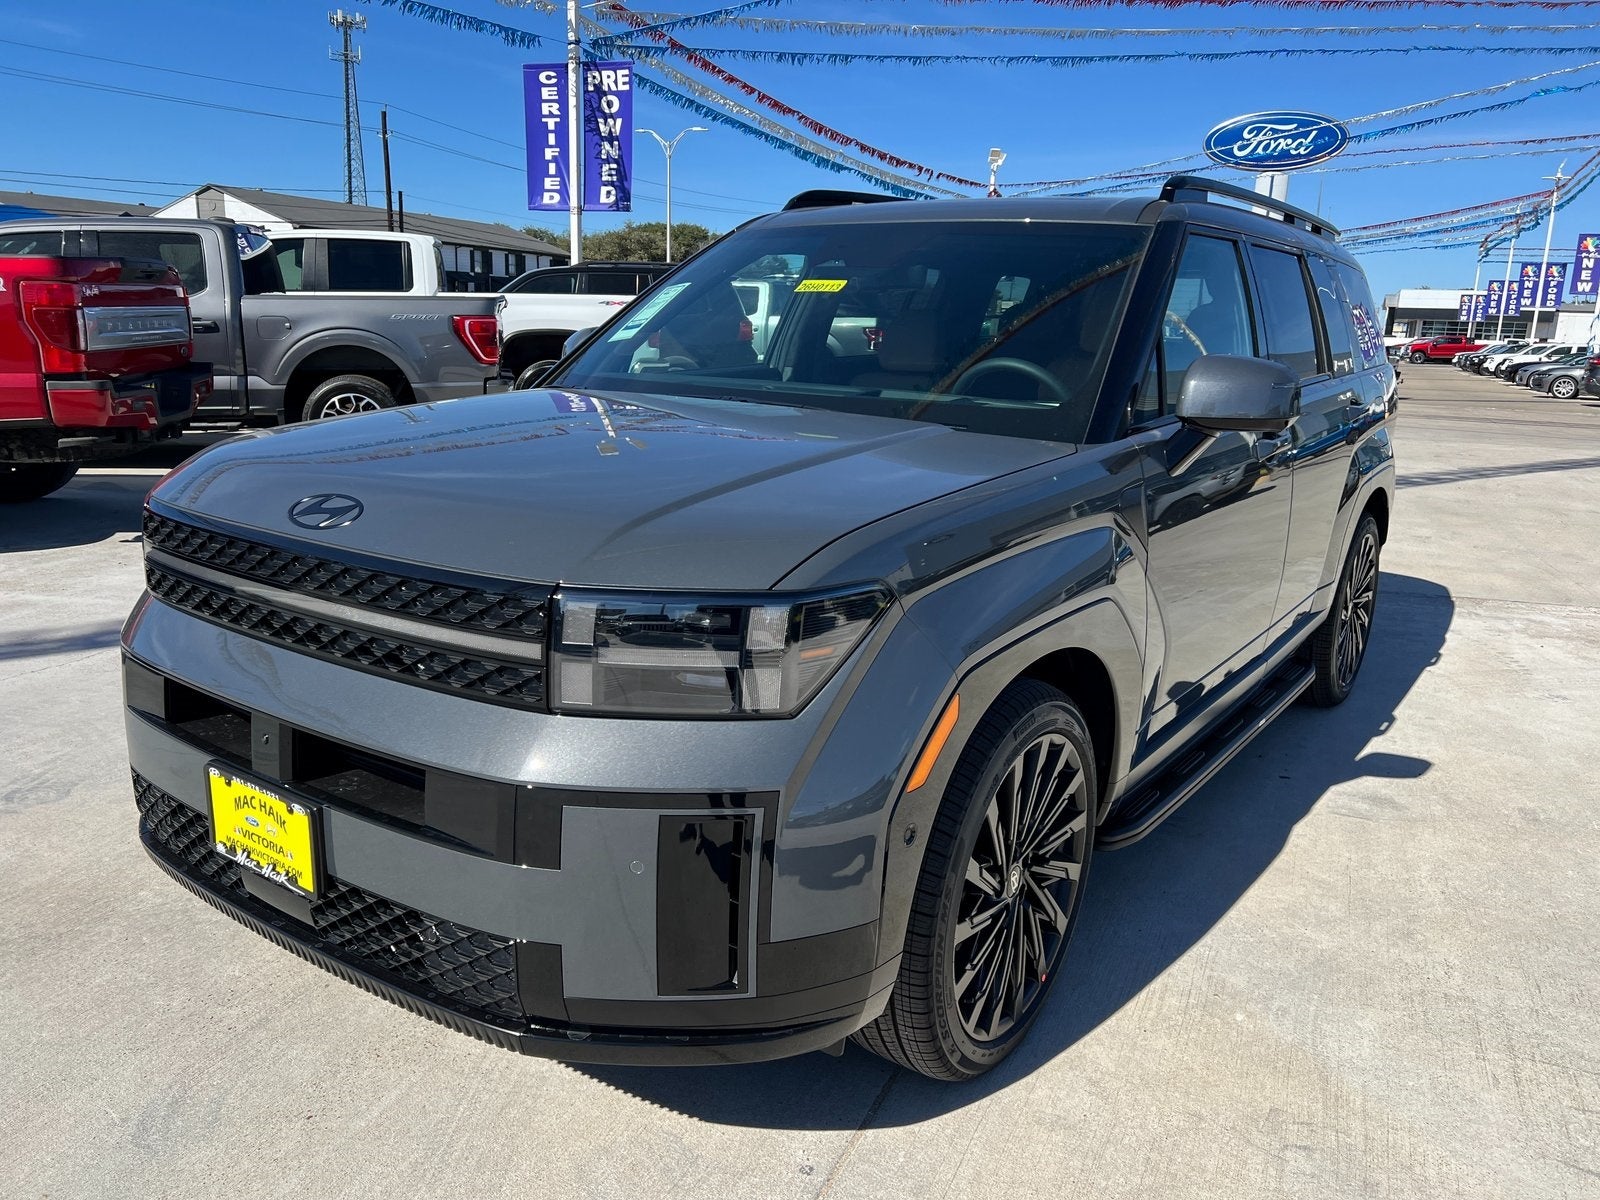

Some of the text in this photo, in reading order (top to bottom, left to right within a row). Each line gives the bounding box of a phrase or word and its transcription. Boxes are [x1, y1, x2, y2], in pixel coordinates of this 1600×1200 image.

[587, 69, 630, 91] PRE
[539, 71, 561, 204] CERTIFIED
[598, 95, 622, 204] OWNED
[1233, 123, 1318, 157] Ford
[1577, 258, 1595, 292] NEW
[1488, 294, 1499, 314] NEW
[1508, 294, 1518, 315] FORD
[1521, 281, 1533, 306] NEW
[1546, 281, 1557, 307] FORD
[234, 794, 257, 812] MAC
[258, 799, 288, 834] HAIK
[240, 827, 285, 856] VICTORIA
[235, 850, 259, 867] Mac
